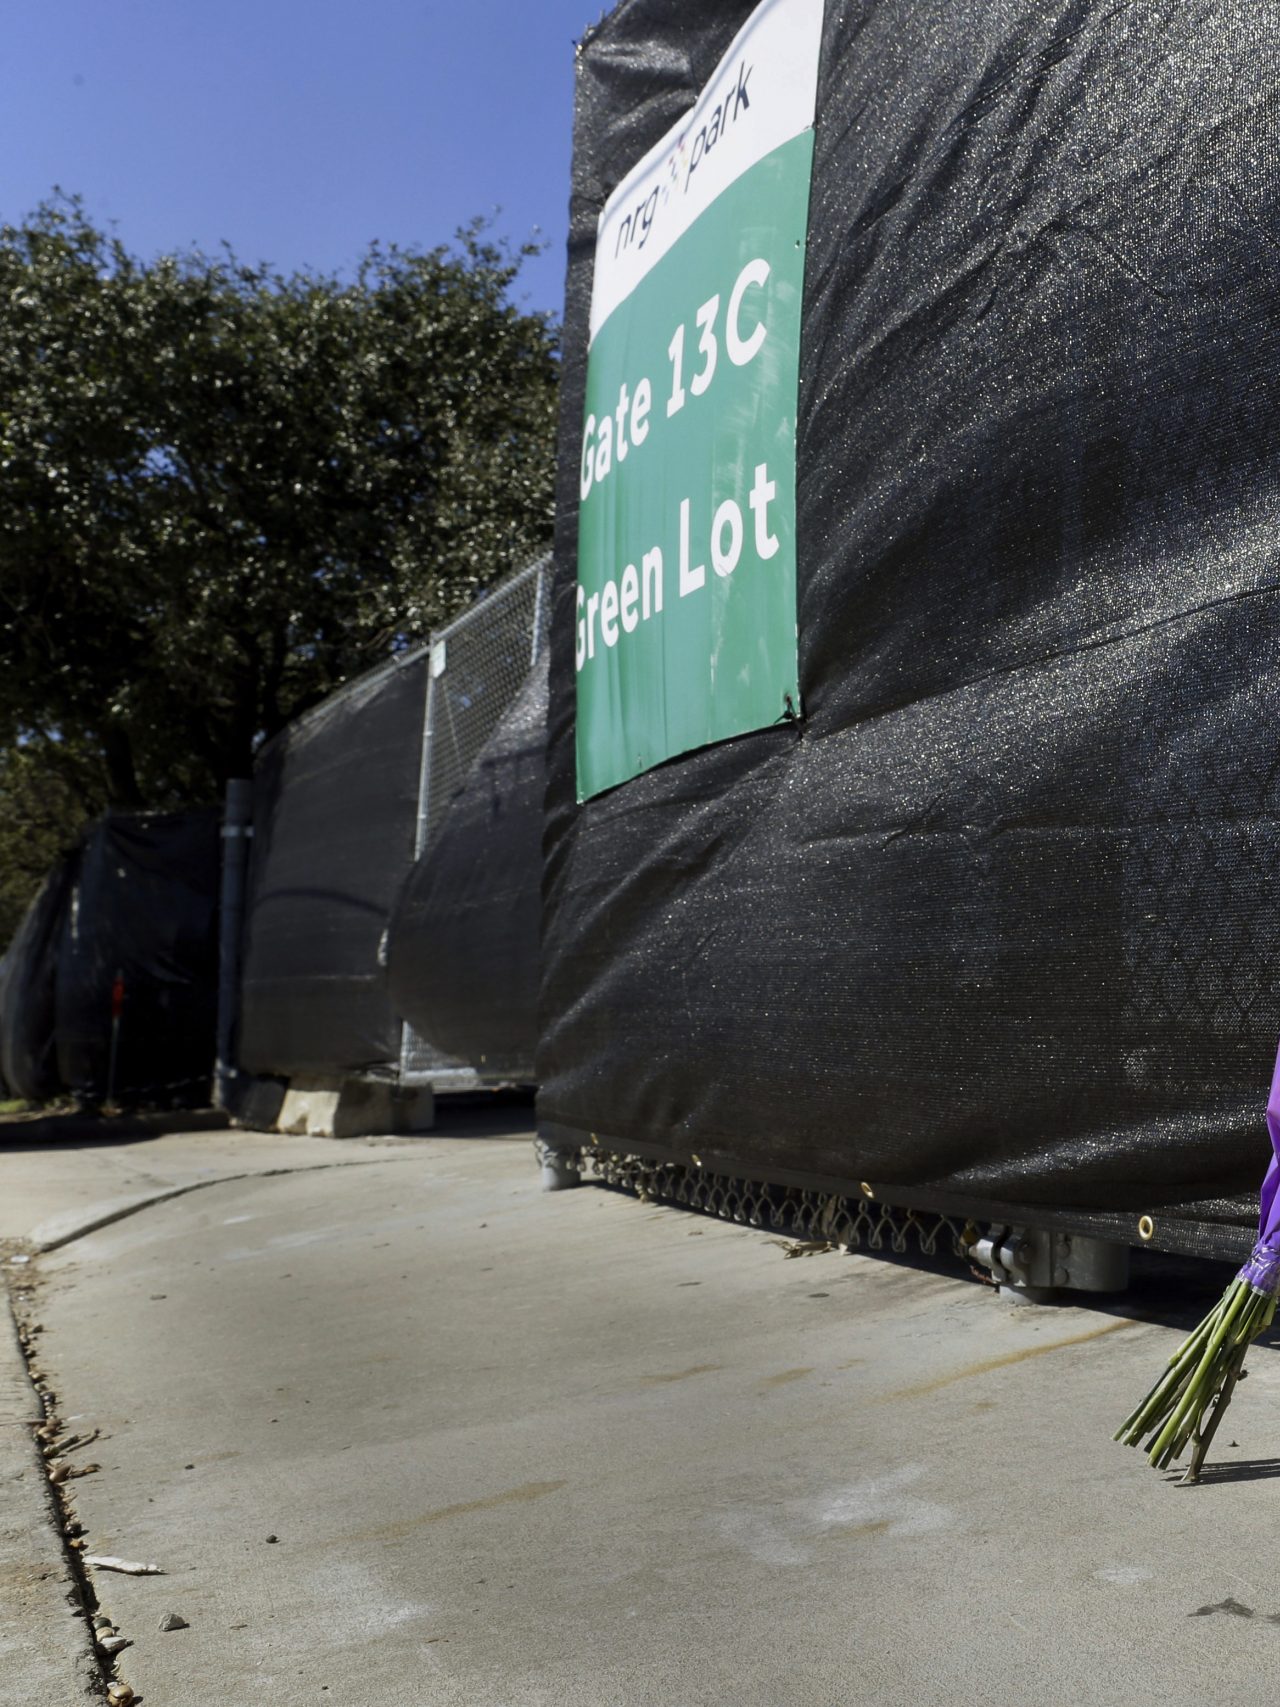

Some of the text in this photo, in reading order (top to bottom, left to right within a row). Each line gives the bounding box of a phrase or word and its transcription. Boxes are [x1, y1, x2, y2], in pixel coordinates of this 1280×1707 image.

[614, 60, 753, 259] nrg park
[580, 257, 771, 501] Gate 13C
[576, 462, 780, 672] Green Lot
